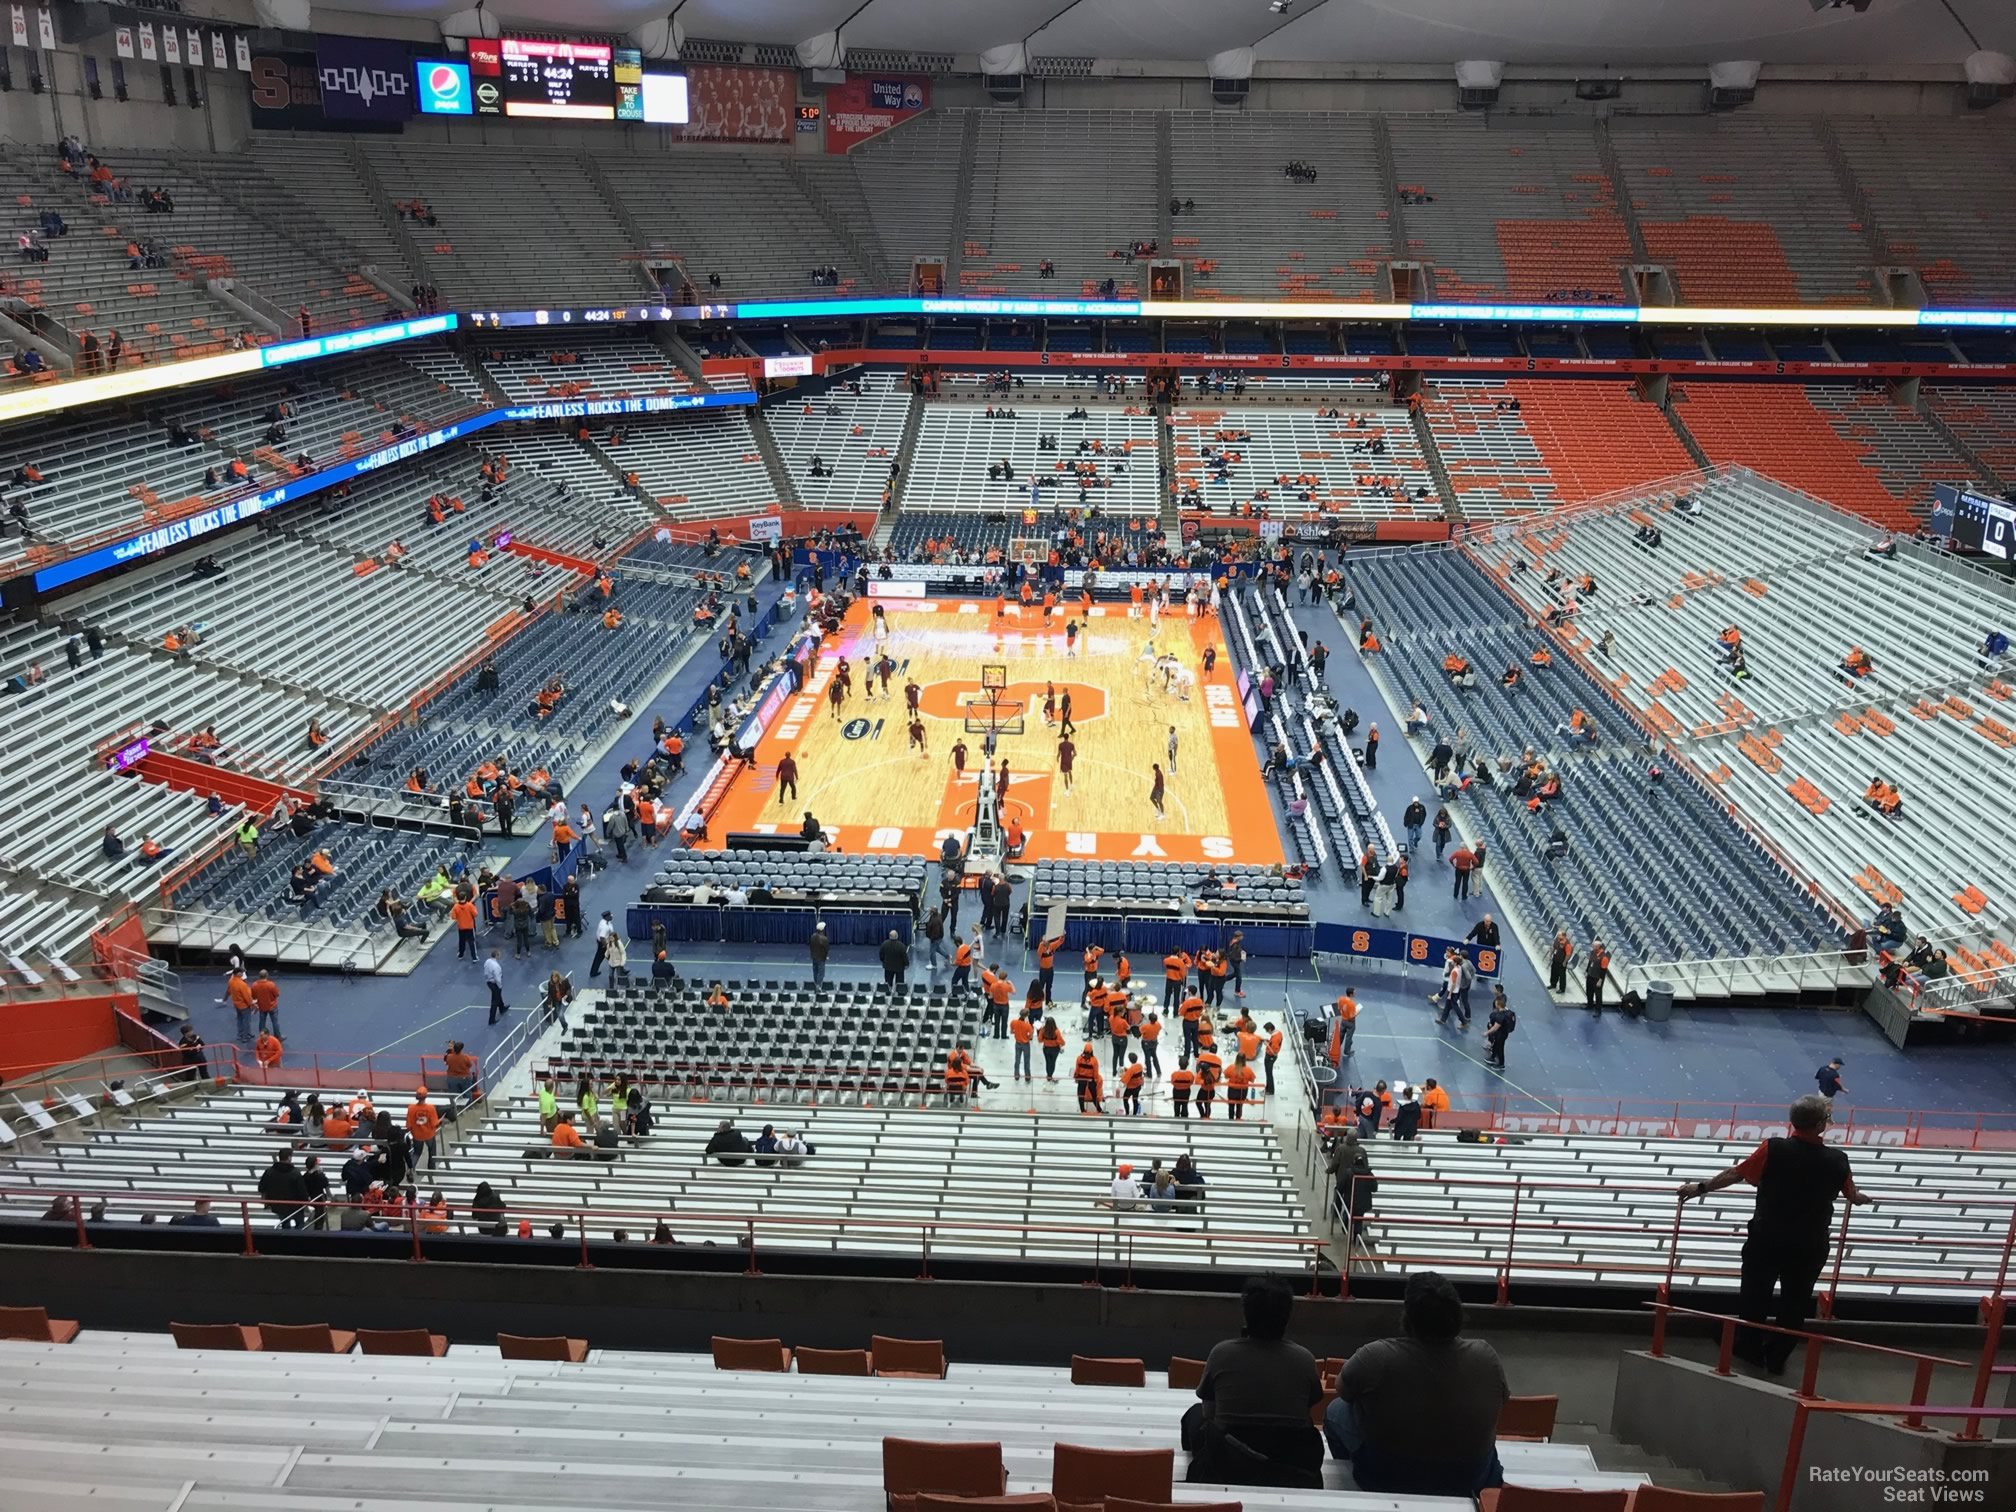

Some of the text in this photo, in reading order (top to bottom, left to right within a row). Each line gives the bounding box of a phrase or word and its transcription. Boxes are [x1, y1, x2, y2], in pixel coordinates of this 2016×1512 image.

[44, 26, 49, 38] 4
[119, 35, 130, 47] 44
[143, 38, 152, 49] 19
[166, 41, 176, 53] 20
[215, 48, 224, 58] 22
[544, 68, 574, 80] 44:24
[251, 57, 290, 109] S
[874, 83, 901, 95] United
[620, 86, 638, 94] TAKE
[624, 94, 634, 102] ME
[884, 95, 902, 108] Way
[617, 108, 642, 118] CROUSE
[563, 309, 648, 322] 0 44:24 1ST 0
[1041, 354, 1049, 364] S
[1282, 356, 1290, 366] S
[1528, 360, 1535, 370] S
[1776, 363, 1784, 373] S
[534, 402, 584, 418] FEARLESS
[588, 400, 622, 415] ROCKS
[625, 398, 643, 412] THE
[139, 520, 190, 554] FEARLESS
[190, 511, 219, 536] ROCKS
[221, 503, 238, 525] THE
[752, 520, 780, 528] KeyBank
[1994, 522, 2004, 541] 0
[870, 584, 878, 594] S
[1352, 930, 1370, 952] S
[1410, 938, 1429, 960] S
[1478, 950, 1496, 972] S
